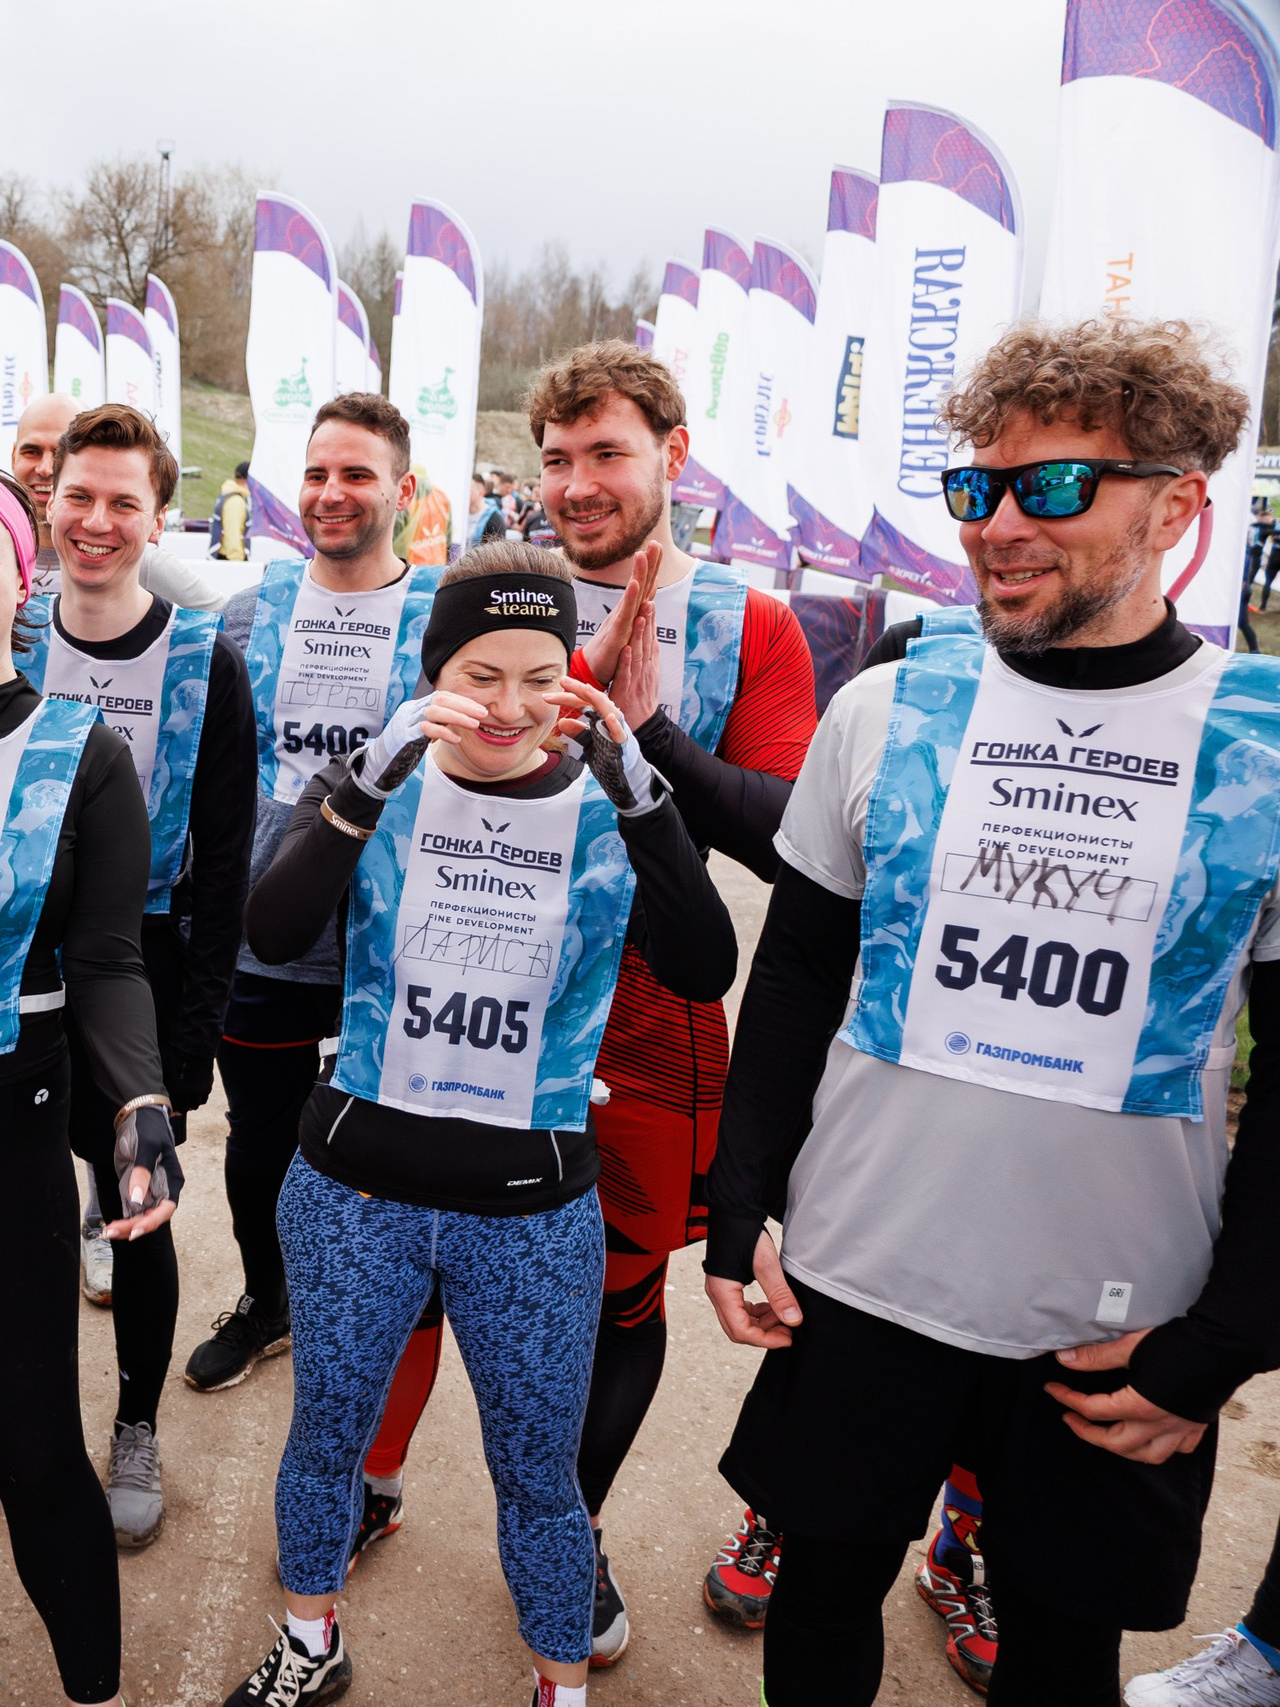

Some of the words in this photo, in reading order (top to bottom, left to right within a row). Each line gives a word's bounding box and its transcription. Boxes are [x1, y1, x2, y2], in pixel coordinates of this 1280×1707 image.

[490, 588, 554, 606] Sminex
[502, 603, 546, 616] team
[294, 619, 336, 631] ГОНКА
[340, 622, 391, 636] ГЕРОЕВ
[303, 638, 372, 659] Sminex
[300, 663, 370, 674] ПЕРФЕКЦИОНИСТЫ
[316, 673, 368, 682] DEVELOPMENT
[97, 695, 153, 711] ГЕРОЕВ
[971, 741, 1059, 763] ГОНКА
[1068, 747, 1180, 779] ГЕРОЕВ
[988, 777, 1139, 822] Sminex
[330, 814, 360, 837] Sminex
[982, 823, 1134, 850] ПЕРФЕКЦИОНИСТЫ
[420, 832, 484, 854] ГОНКА
[490, 840, 563, 867] ГЕРОЕВ
[978, 838, 1011, 851] FINE
[1018, 843, 1130, 866] DEVELOPMENT
[435, 865, 537, 901] Sminex
[430, 900, 537, 922] ПЕРФЕКЦИОНИСТЫ
[428, 913, 453, 925] FINE
[456, 916, 535, 936] DEVELOPMENT
[935, 924, 1130, 1017] 5400
[403, 984, 530, 1054] 5405
[976, 1041, 1085, 1074] ГАЗПРОМБАНК
[431, 1080, 506, 1101] ГАЗПРОМБАНК
[506, 1177, 543, 1187] DEMIX
